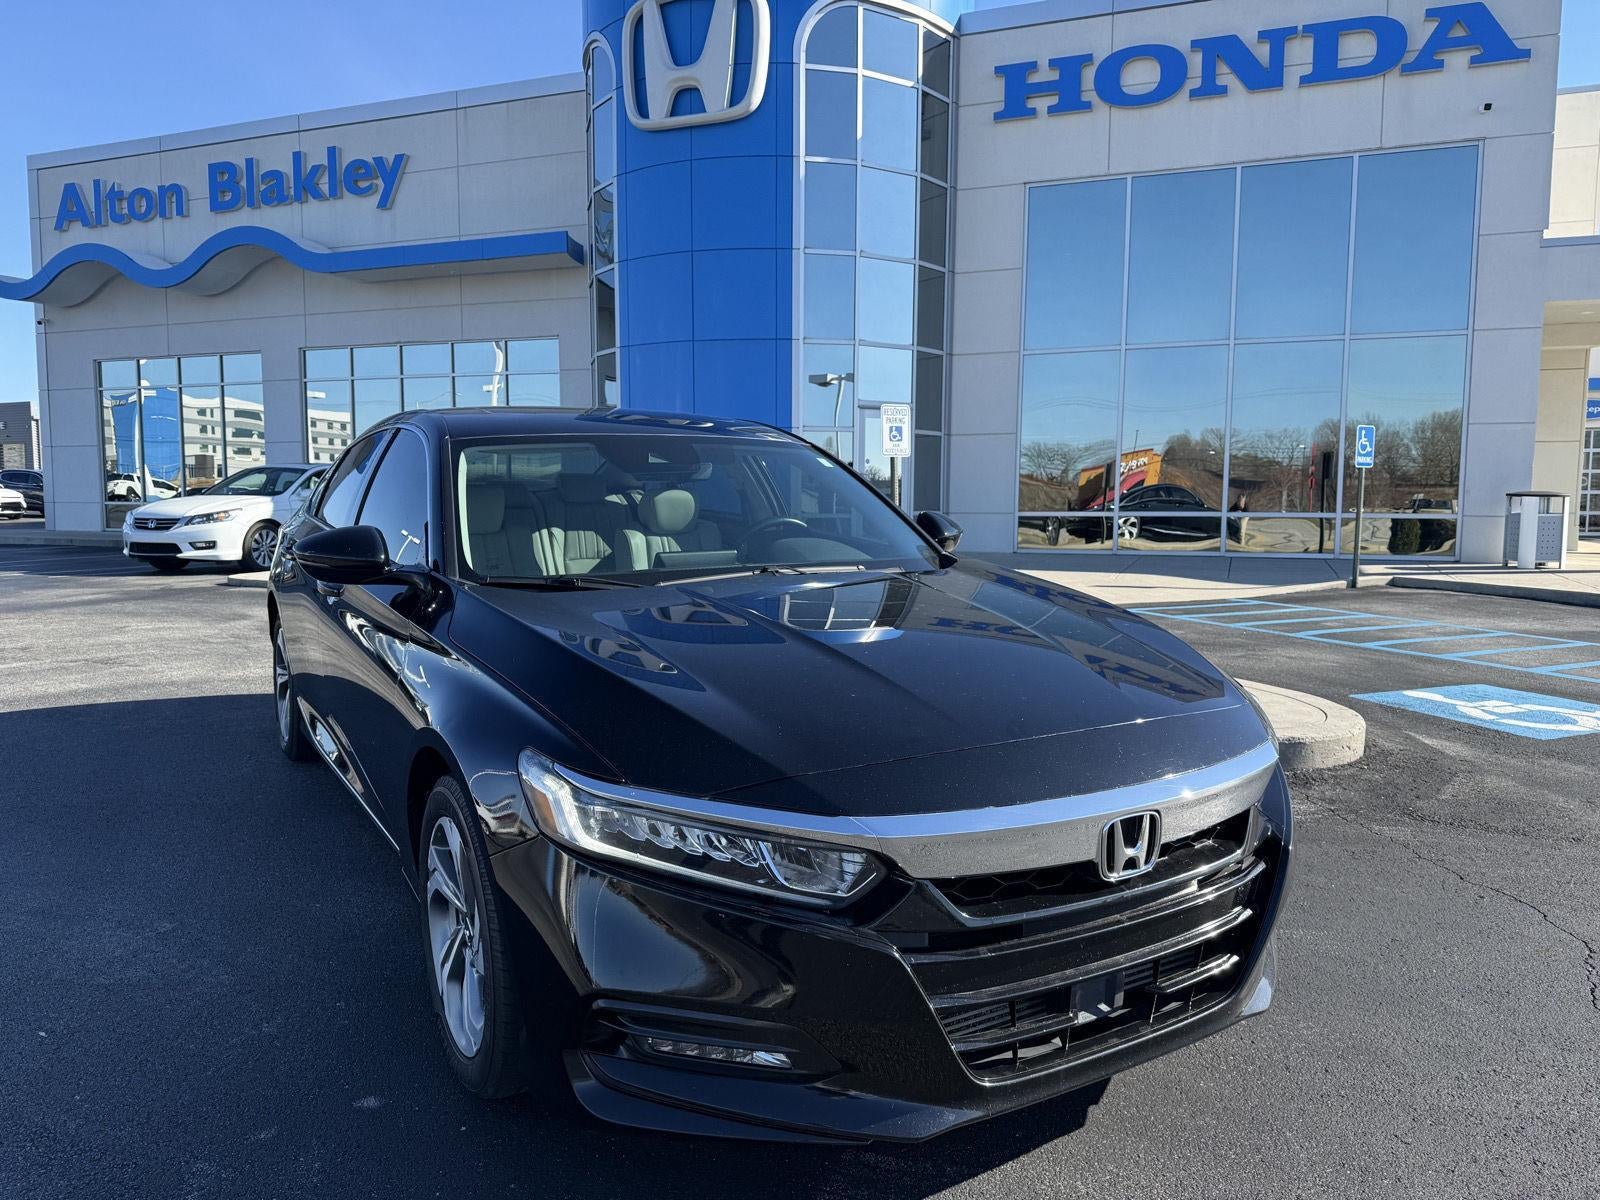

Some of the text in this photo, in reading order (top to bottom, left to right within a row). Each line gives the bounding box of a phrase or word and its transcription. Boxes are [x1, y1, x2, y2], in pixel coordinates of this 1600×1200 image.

[993, 1, 1531, 122] HONDA
[54, 145, 409, 232] Alton Blakley
[884, 407, 908, 417] RESERVED
[885, 417, 906, 425] PARKING
